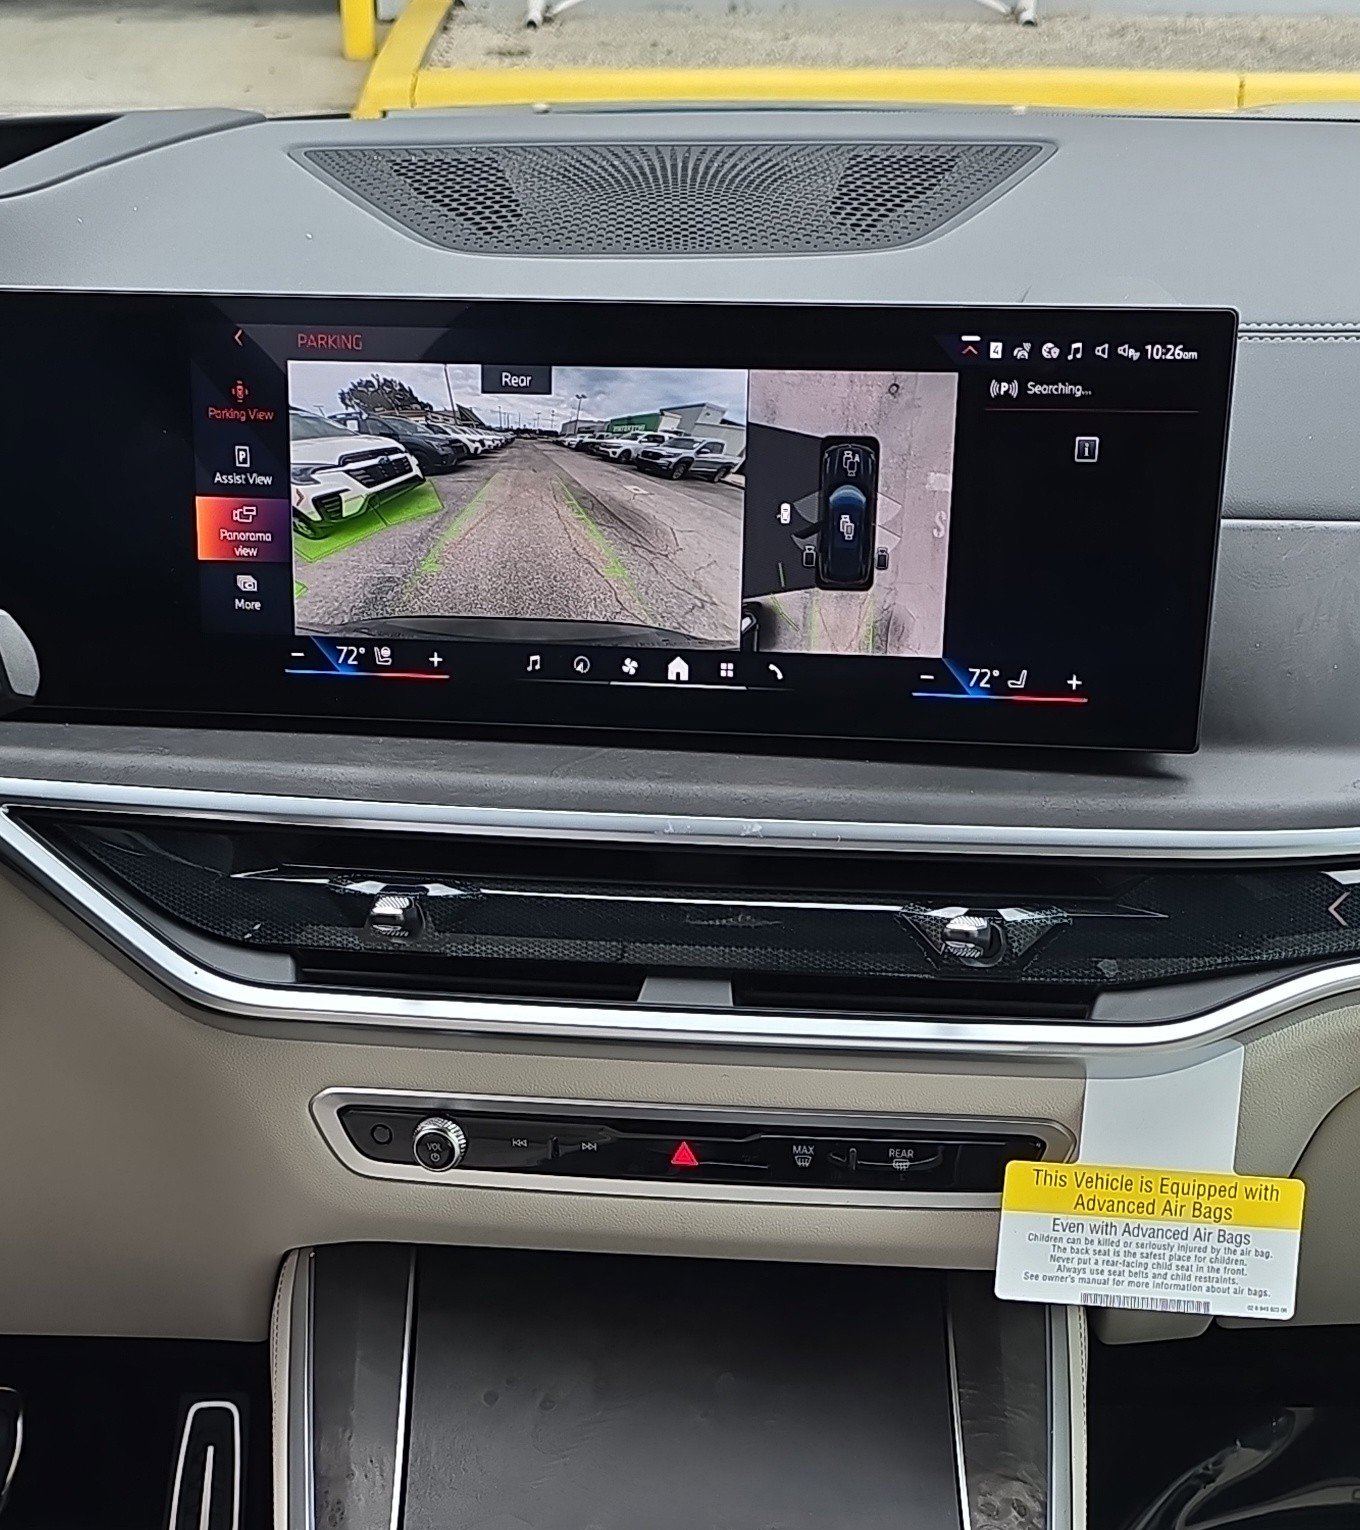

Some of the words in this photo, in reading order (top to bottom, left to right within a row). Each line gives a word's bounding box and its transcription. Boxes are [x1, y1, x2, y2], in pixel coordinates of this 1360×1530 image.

[297, 333, 363, 350] PARKING
[1144, 344, 1198, 360] 10:26am
[501, 371, 533, 387] Rear
[1026, 382, 1092, 398] Searching...
[207, 407, 247, 422] Parking
[247, 409, 275, 421] View
[213, 472, 247, 485] Assist
[247, 473, 273, 485] View
[219, 529, 272, 542] Panorama
[234, 545, 258, 557] view
[234, 599, 262, 611] More
[426, 1142, 442, 1152] VOL
[792, 1145, 815, 1155] MAX
[889, 1149, 914, 1159] REAR
[1033, 1168, 1068, 1188] This
[1074, 1171, 1133, 1192] Vehicle
[1139, 1175, 1153, 1193] is
[1159, 1177, 1238, 1201] Equipped
[1244, 1183, 1280, 1202] with
[1073, 1193, 1156, 1215] Advanced
[1161, 1199, 1186, 1218] Air
[1191, 1201, 1233, 1223] Bags
[1052, 1217, 1084, 1234] Even
[1089, 1220, 1118, 1236] with
[1121, 1222, 1189, 1241] Advanced
[1193, 1227, 1213, 1241] Air
[1217, 1228, 1251, 1247] Bags
[1028, 1232, 1064, 1244] Children
[1066, 1236, 1081, 1245] can
[1084, 1236, 1095, 1246] be
[1097, 1237, 1121, 1248] killed
[1123, 1240, 1132, 1248] or
[1135, 1240, 1174, 1253] seriously
[1177, 1243, 1207, 1254] injured
[1211, 1245, 1220, 1256] by
[1223, 1246, 1237, 1256] the
[1240, 1248, 1251, 1257] air
[1254, 1249, 1273, 1260] bag.
[1051, 1244, 1067, 1254] The
[1070, 1245, 1090, 1255] back
[1092, 1247, 1110, 1257] seat
[1113, 1248, 1120, 1258] is
[1123, 1248, 1137, 1259] the
[1140, 1250, 1166, 1261] safest
[1168, 1252, 1191, 1264] place
[1194, 1254, 1206, 1263] for
[1209, 1256, 1248, 1267] children.
[1049, 1254, 1074, 1264] Never
[1077, 1256, 1091, 1267] put
[1093, 1258, 1099, 1266] a
[1101, 1258, 1149, 1271] rear-facing
[1151, 1261, 1172, 1271] child
[1175, 1263, 1193, 1272] seat
[1195, 1263, 1204, 1273] in
[1207, 1264, 1220, 1274] the
[1223, 1265, 1248, 1276] front.
[1056, 1264, 1087, 1276] Always
[1089, 1267, 1105, 1276] use
[1107, 1268, 1125, 1278] seat
[1128, 1269, 1149, 1279] belts
[1151, 1271, 1168, 1280] and
[1170, 1272, 1192, 1282] child
[1194, 1274, 1239, 1285] restraints.
[1023, 1271, 1040, 1281] See
[1042, 1273, 1076, 1284] owner's
[1078, 1276, 1109, 1286] manual
[1112, 1277, 1124, 1287] for
[1127, 1279, 1150, 1289] more
[1152, 1281, 1203, 1293] information
[1205, 1284, 1230, 1295] about
[1233, 1286, 1245, 1296] air
[1247, 1287, 1271, 1298] bags.
